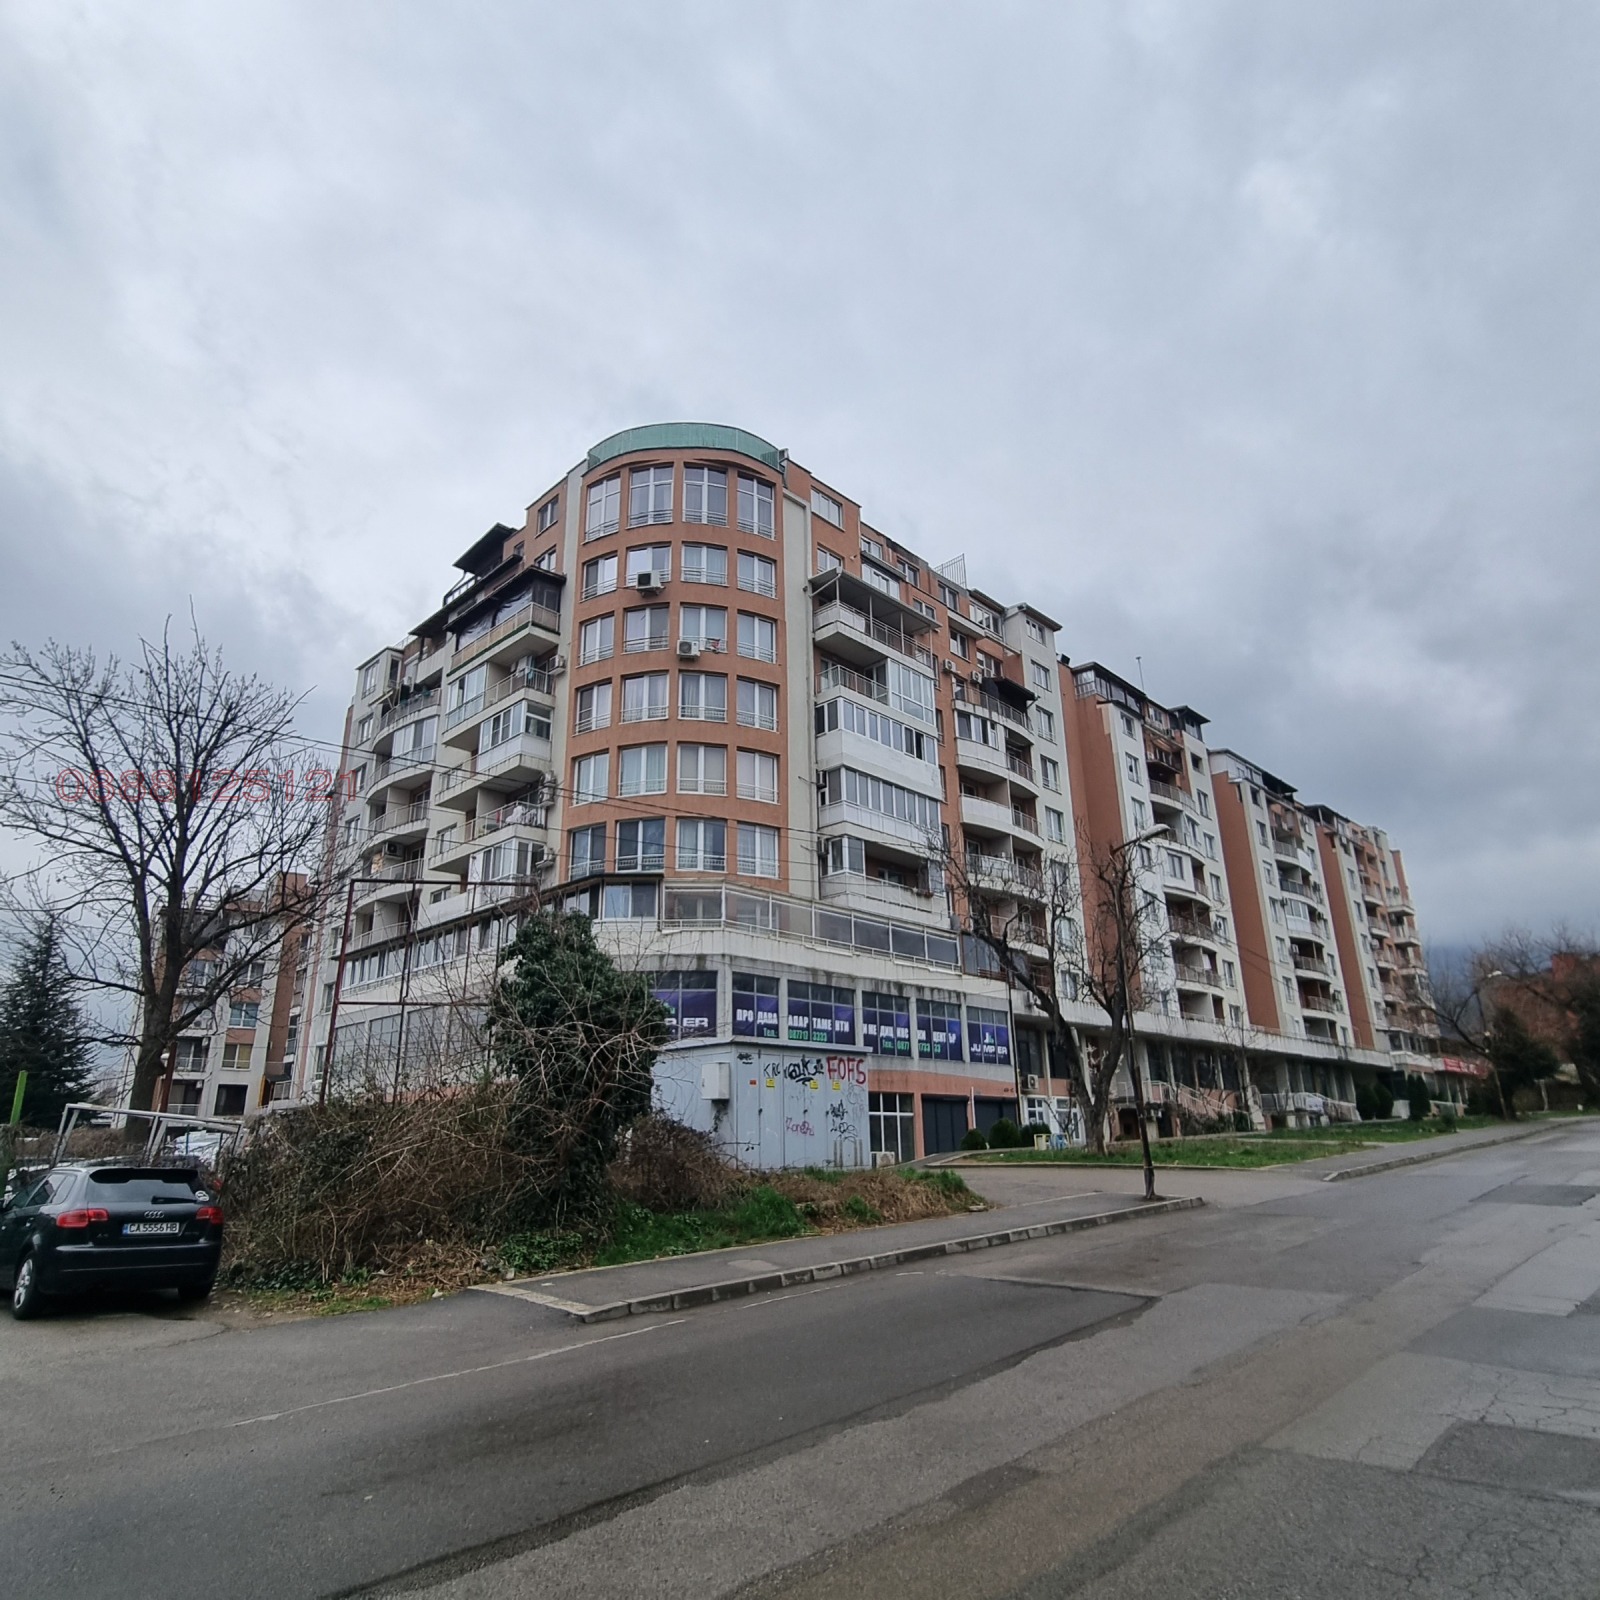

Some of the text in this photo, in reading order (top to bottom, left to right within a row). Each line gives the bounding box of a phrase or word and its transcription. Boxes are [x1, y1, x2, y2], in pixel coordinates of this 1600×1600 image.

[970, 1043, 1008, 1055] JUMPER
[826, 1055, 867, 1085] FOFS
[142, 1222, 165, 1233] 5556
